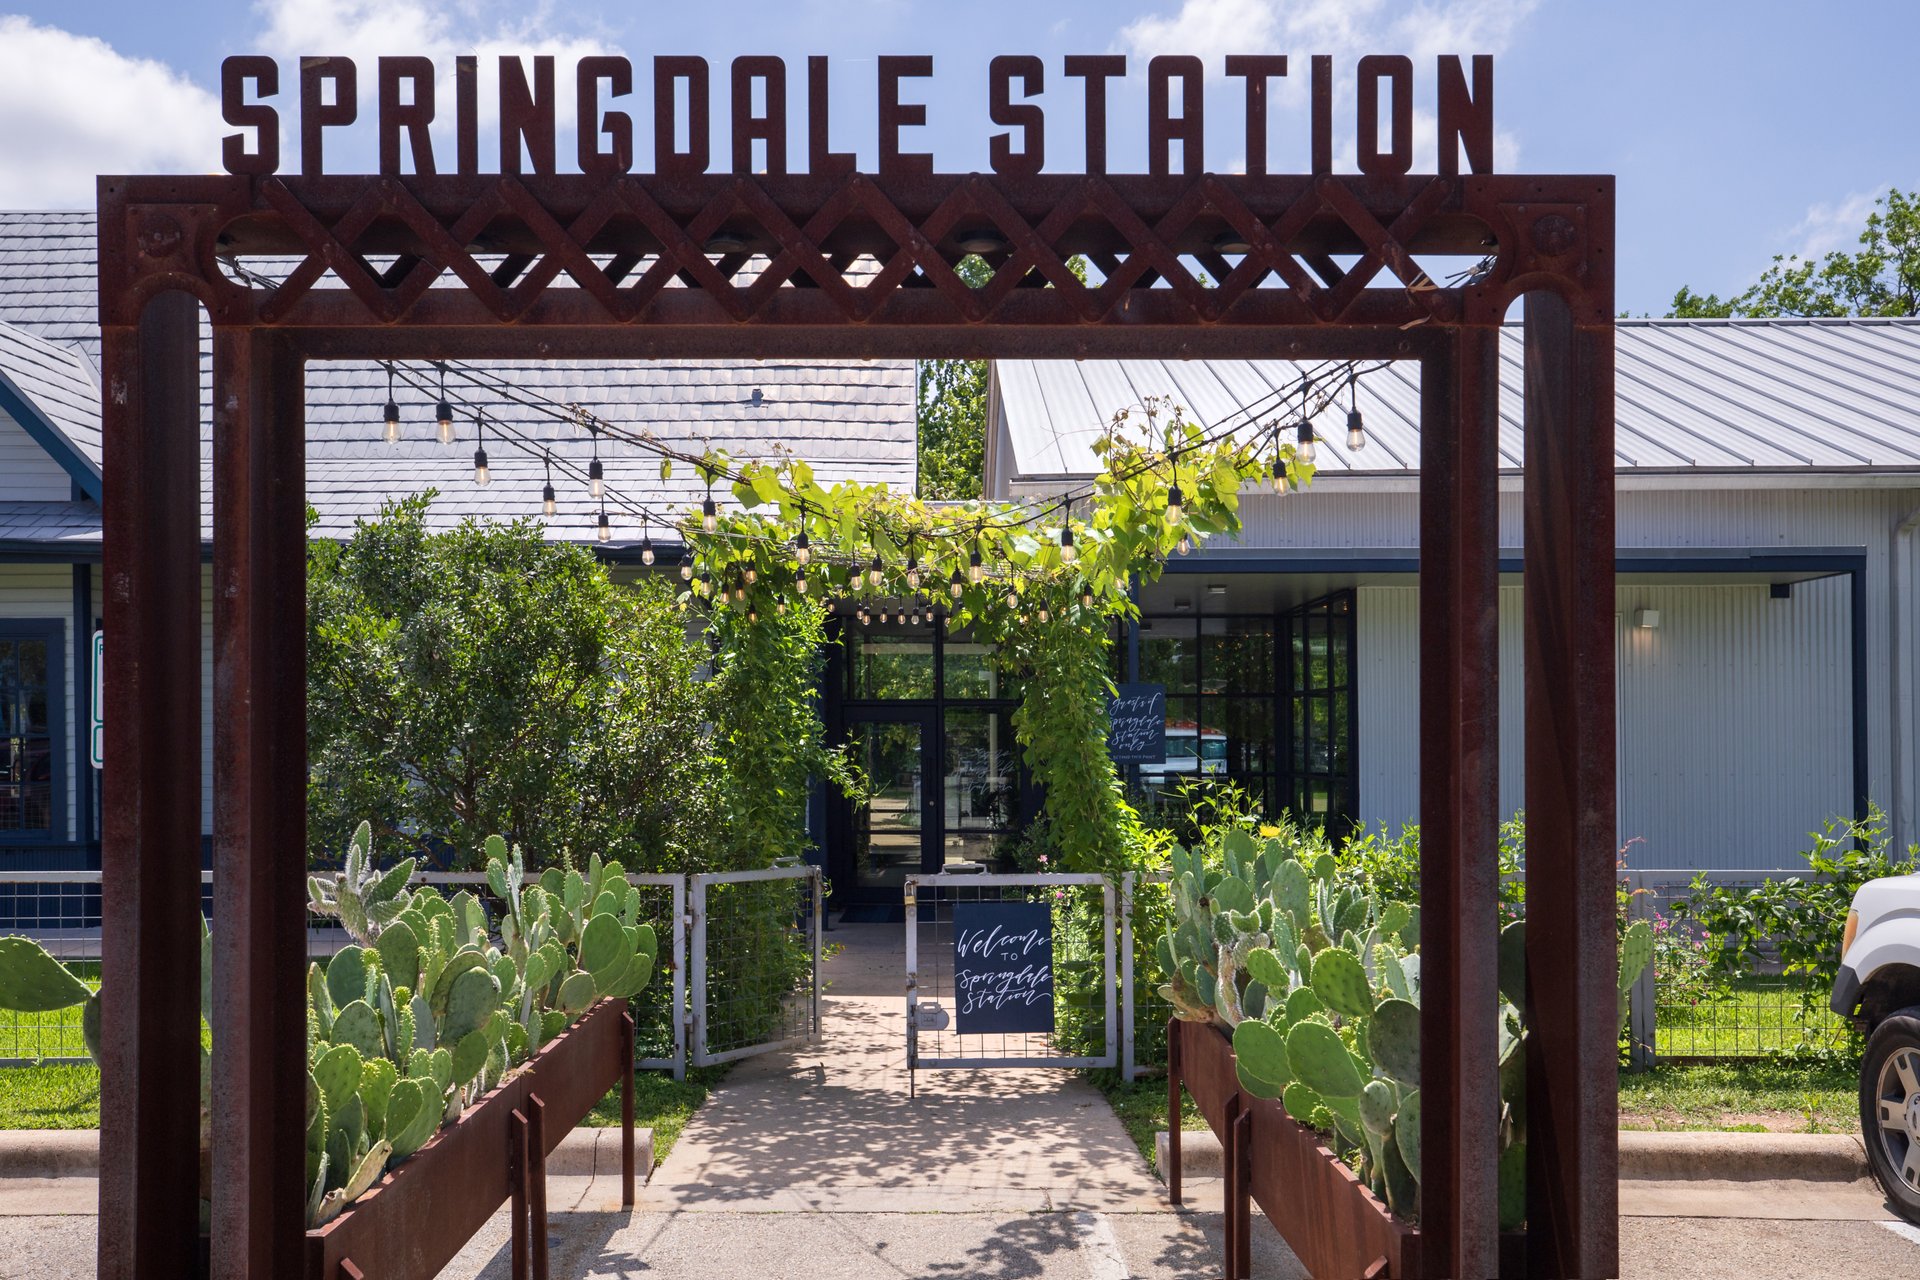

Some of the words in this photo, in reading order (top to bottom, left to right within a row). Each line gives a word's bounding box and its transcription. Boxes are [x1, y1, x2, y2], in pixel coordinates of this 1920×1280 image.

[222, 55, 934, 175] SPRINGDALE
[989, 54, 1494, 175] STATION
[957, 924, 1052, 958] Welcome
[1000, 952, 1019, 961] TO
[955, 964, 1053, 993] Springdale
[962, 985, 1052, 1014] Station
